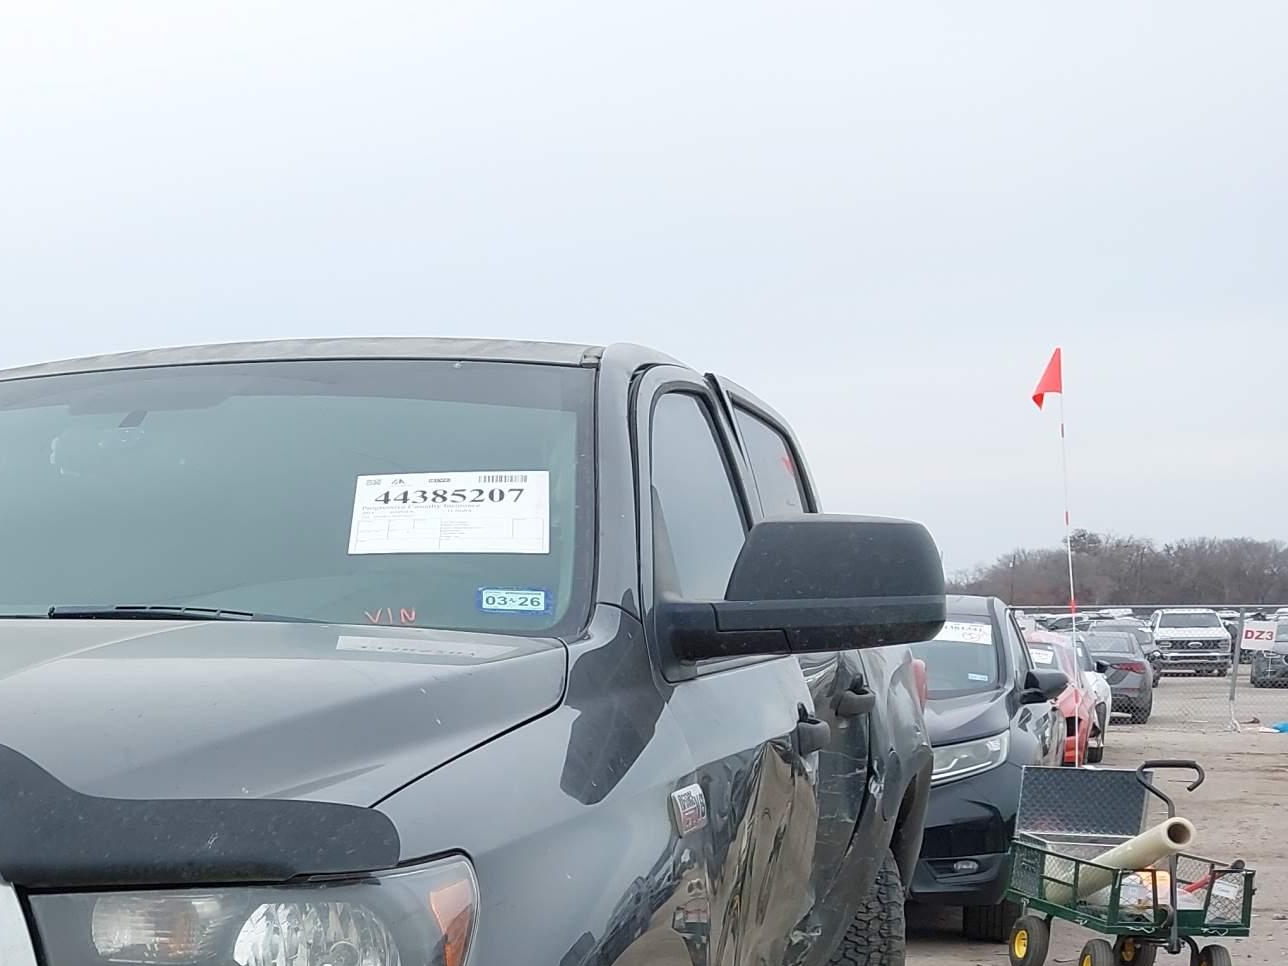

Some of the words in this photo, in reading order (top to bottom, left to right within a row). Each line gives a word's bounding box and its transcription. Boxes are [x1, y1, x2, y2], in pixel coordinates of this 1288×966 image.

[374, 488, 525, 505] 44385207
[364, 607, 417, 625] VIN
[1244, 629, 1274, 641] DZ3
